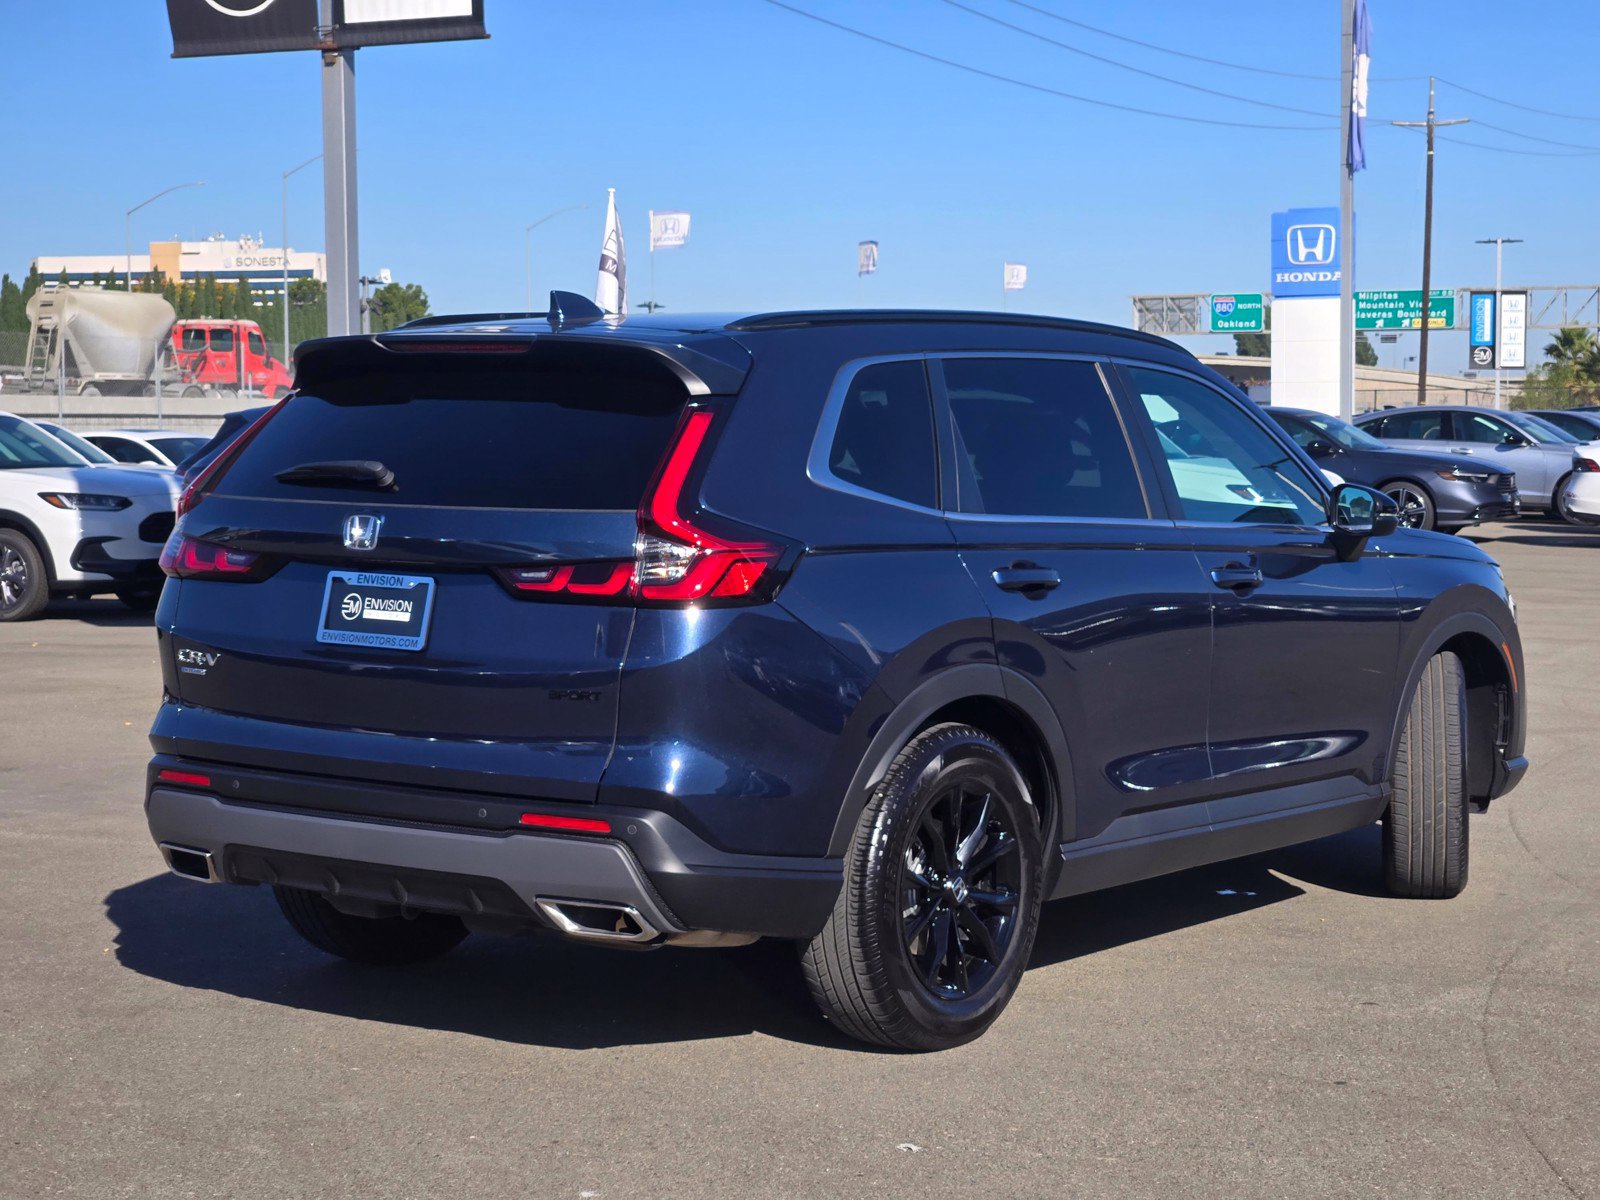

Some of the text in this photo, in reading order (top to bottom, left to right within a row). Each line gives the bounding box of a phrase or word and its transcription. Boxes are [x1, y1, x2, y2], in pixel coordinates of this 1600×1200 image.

[236, 256, 290, 267] SONESTA
[1276, 271, 1341, 283] HONDA
[1358, 292, 1398, 301] Milpitas
[1215, 303, 1233, 313] 880
[1358, 300, 1432, 309] Mountain Vie
[1397, 308, 1446, 318] Bouleard
[1217, 320, 1256, 328] Oakland
[1475, 298, 1485, 342] ENVISION
[357, 574, 404, 587] ENVISION
[364, 597, 413, 612] ENVISION
[321, 631, 418, 648] ENVISIONMOTORS.COM
